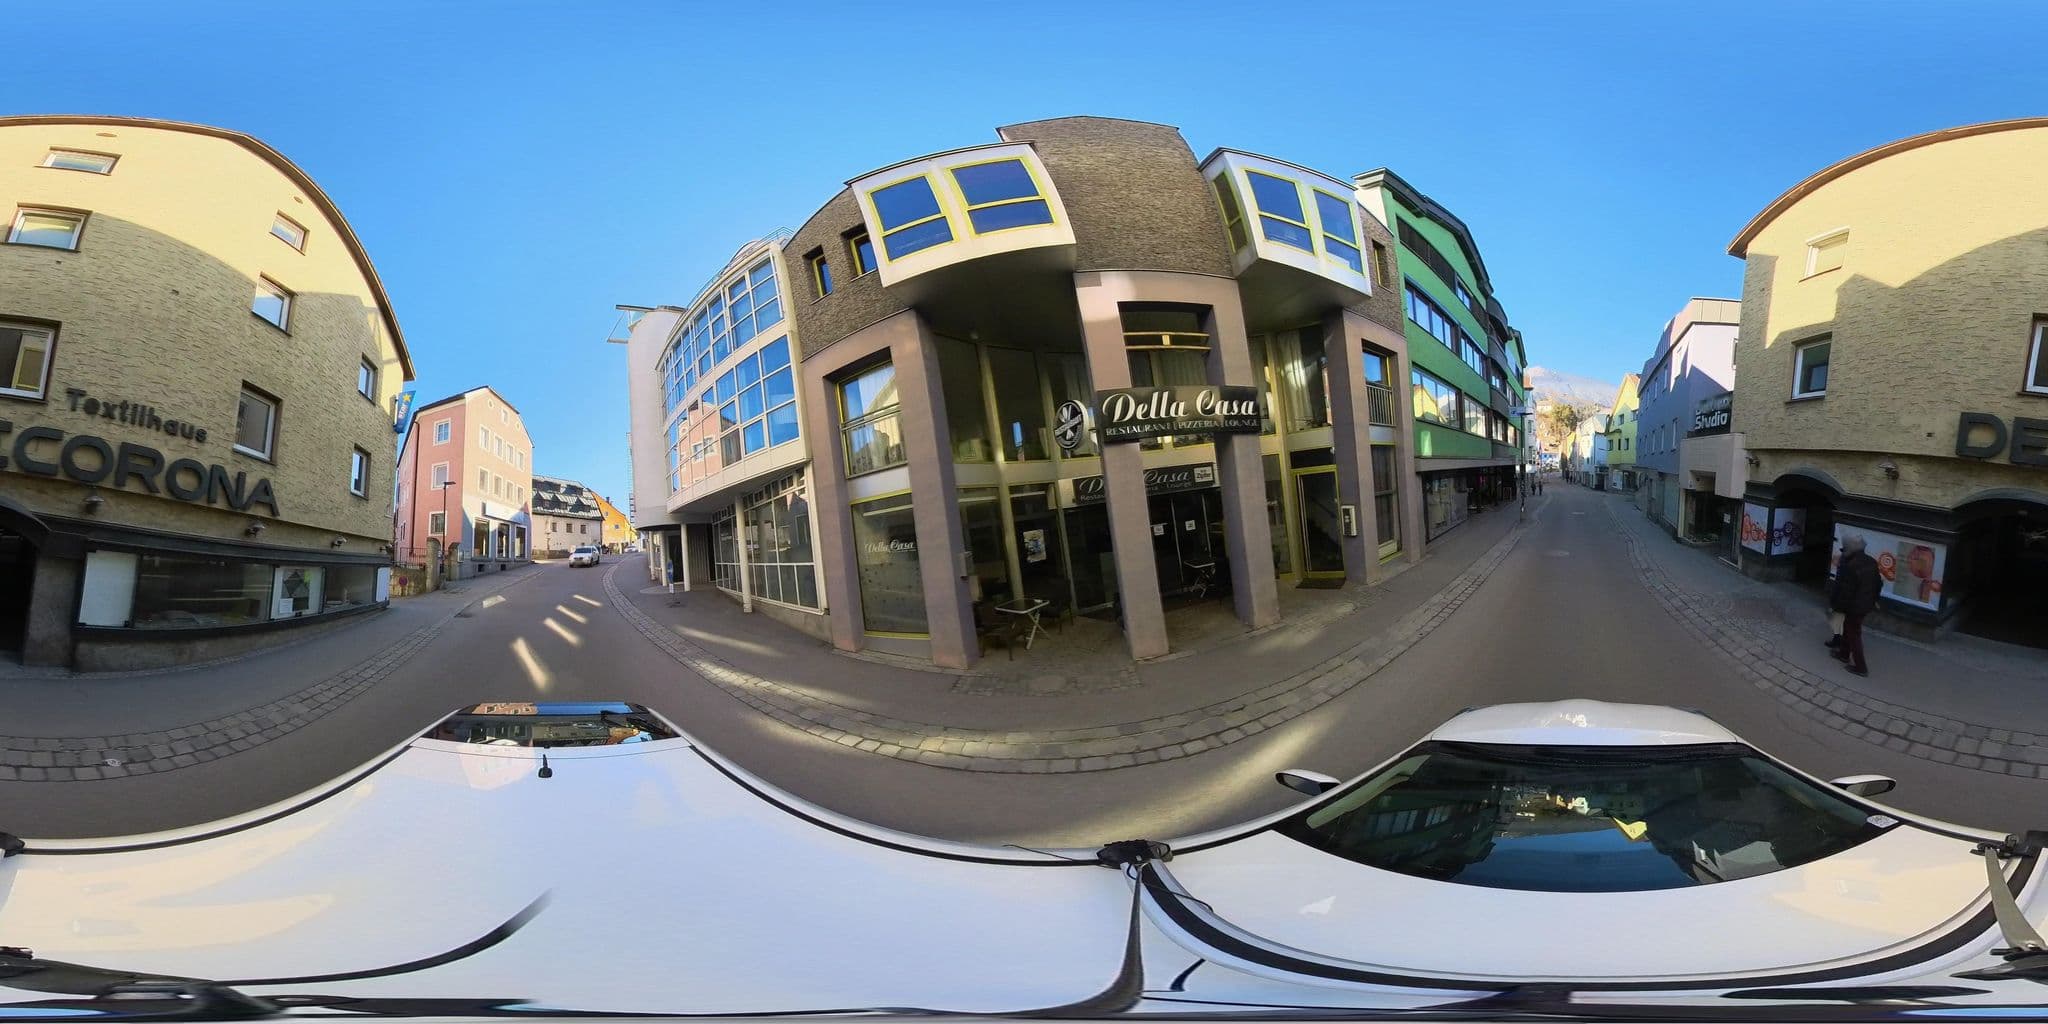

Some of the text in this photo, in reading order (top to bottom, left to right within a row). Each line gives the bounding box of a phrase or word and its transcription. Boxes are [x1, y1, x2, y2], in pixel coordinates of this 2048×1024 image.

[66, 387, 208, 442] Textilhaus
[1102, 389, 1257, 423] Della Casa
[1695, 410, 1728, 430] Studio
[1106, 418, 1260, 436] RESTAURANT PIZZERIA LOUNGE
[0, 421, 280, 517] CORONA
